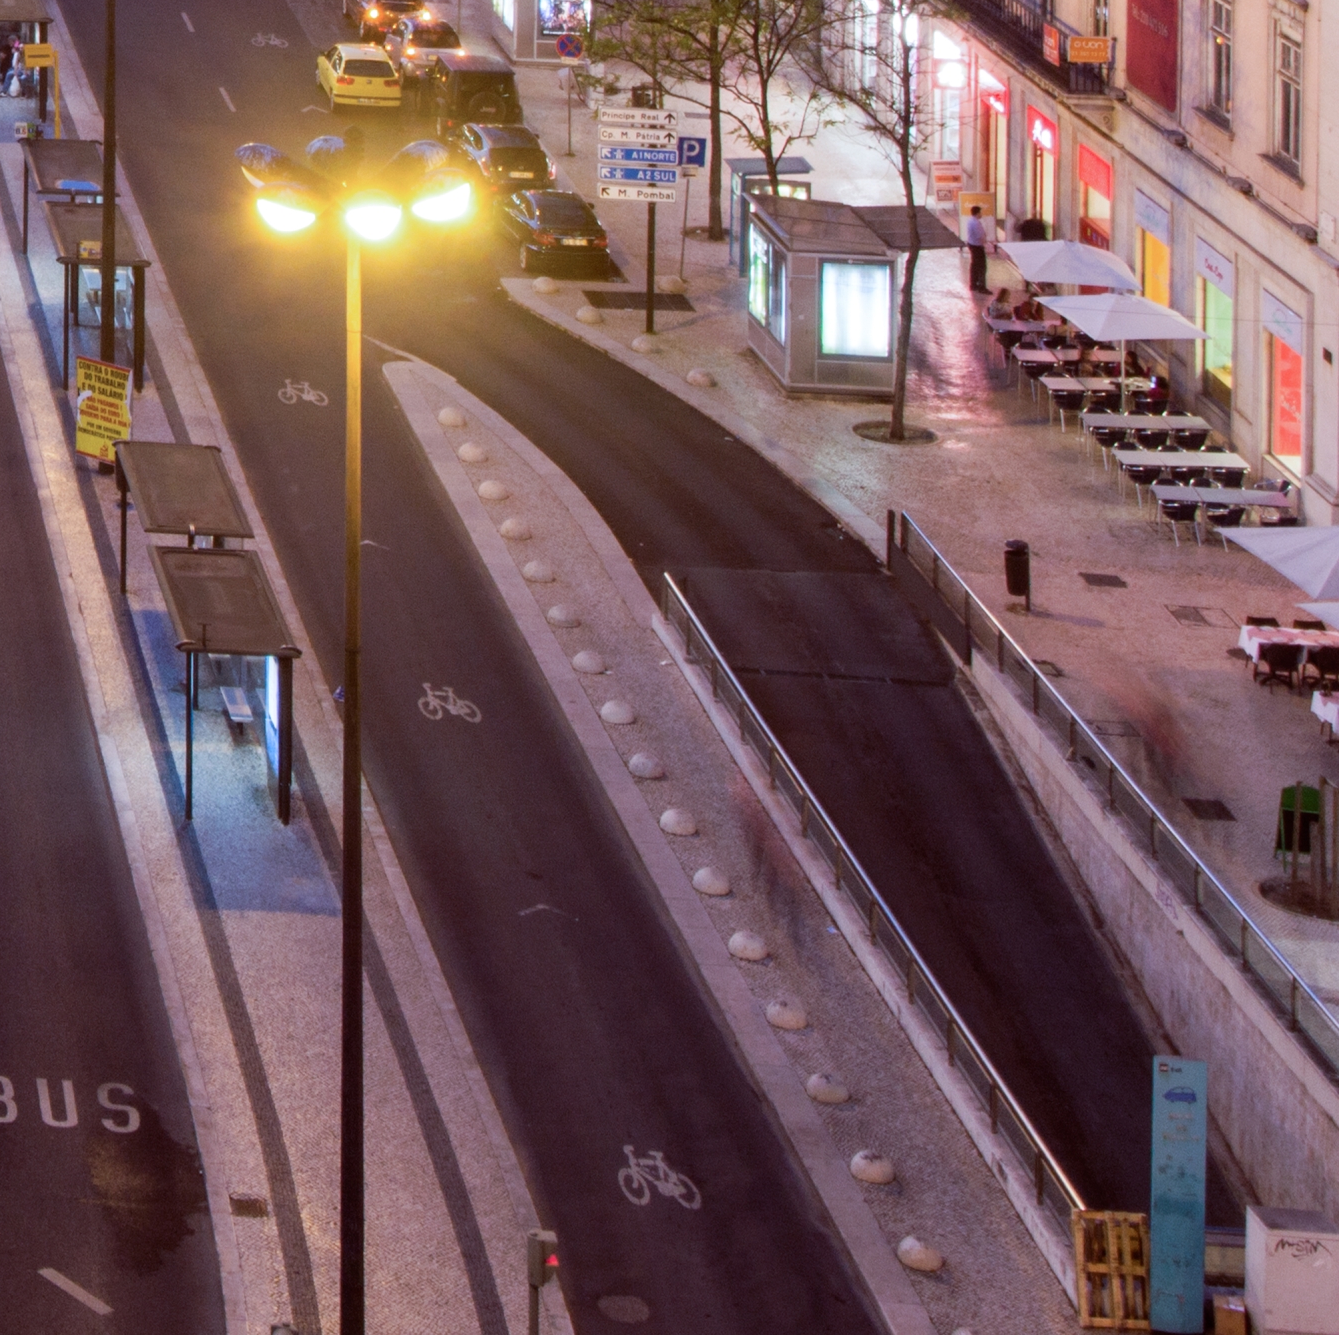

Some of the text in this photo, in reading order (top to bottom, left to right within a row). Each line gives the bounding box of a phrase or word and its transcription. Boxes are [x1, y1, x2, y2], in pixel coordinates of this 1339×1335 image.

[641, 113, 659, 121] Real
[621, 131, 630, 139] M.
[683, 140, 700, 165] P
[637, 171, 675, 181] A2 SUL
[618, 189, 675, 200] M. Pombal
[78, 361, 103, 376] CONTRA
[84, 371, 126, 391] DO TRABALHO
[87, 383, 96, 394] DO
